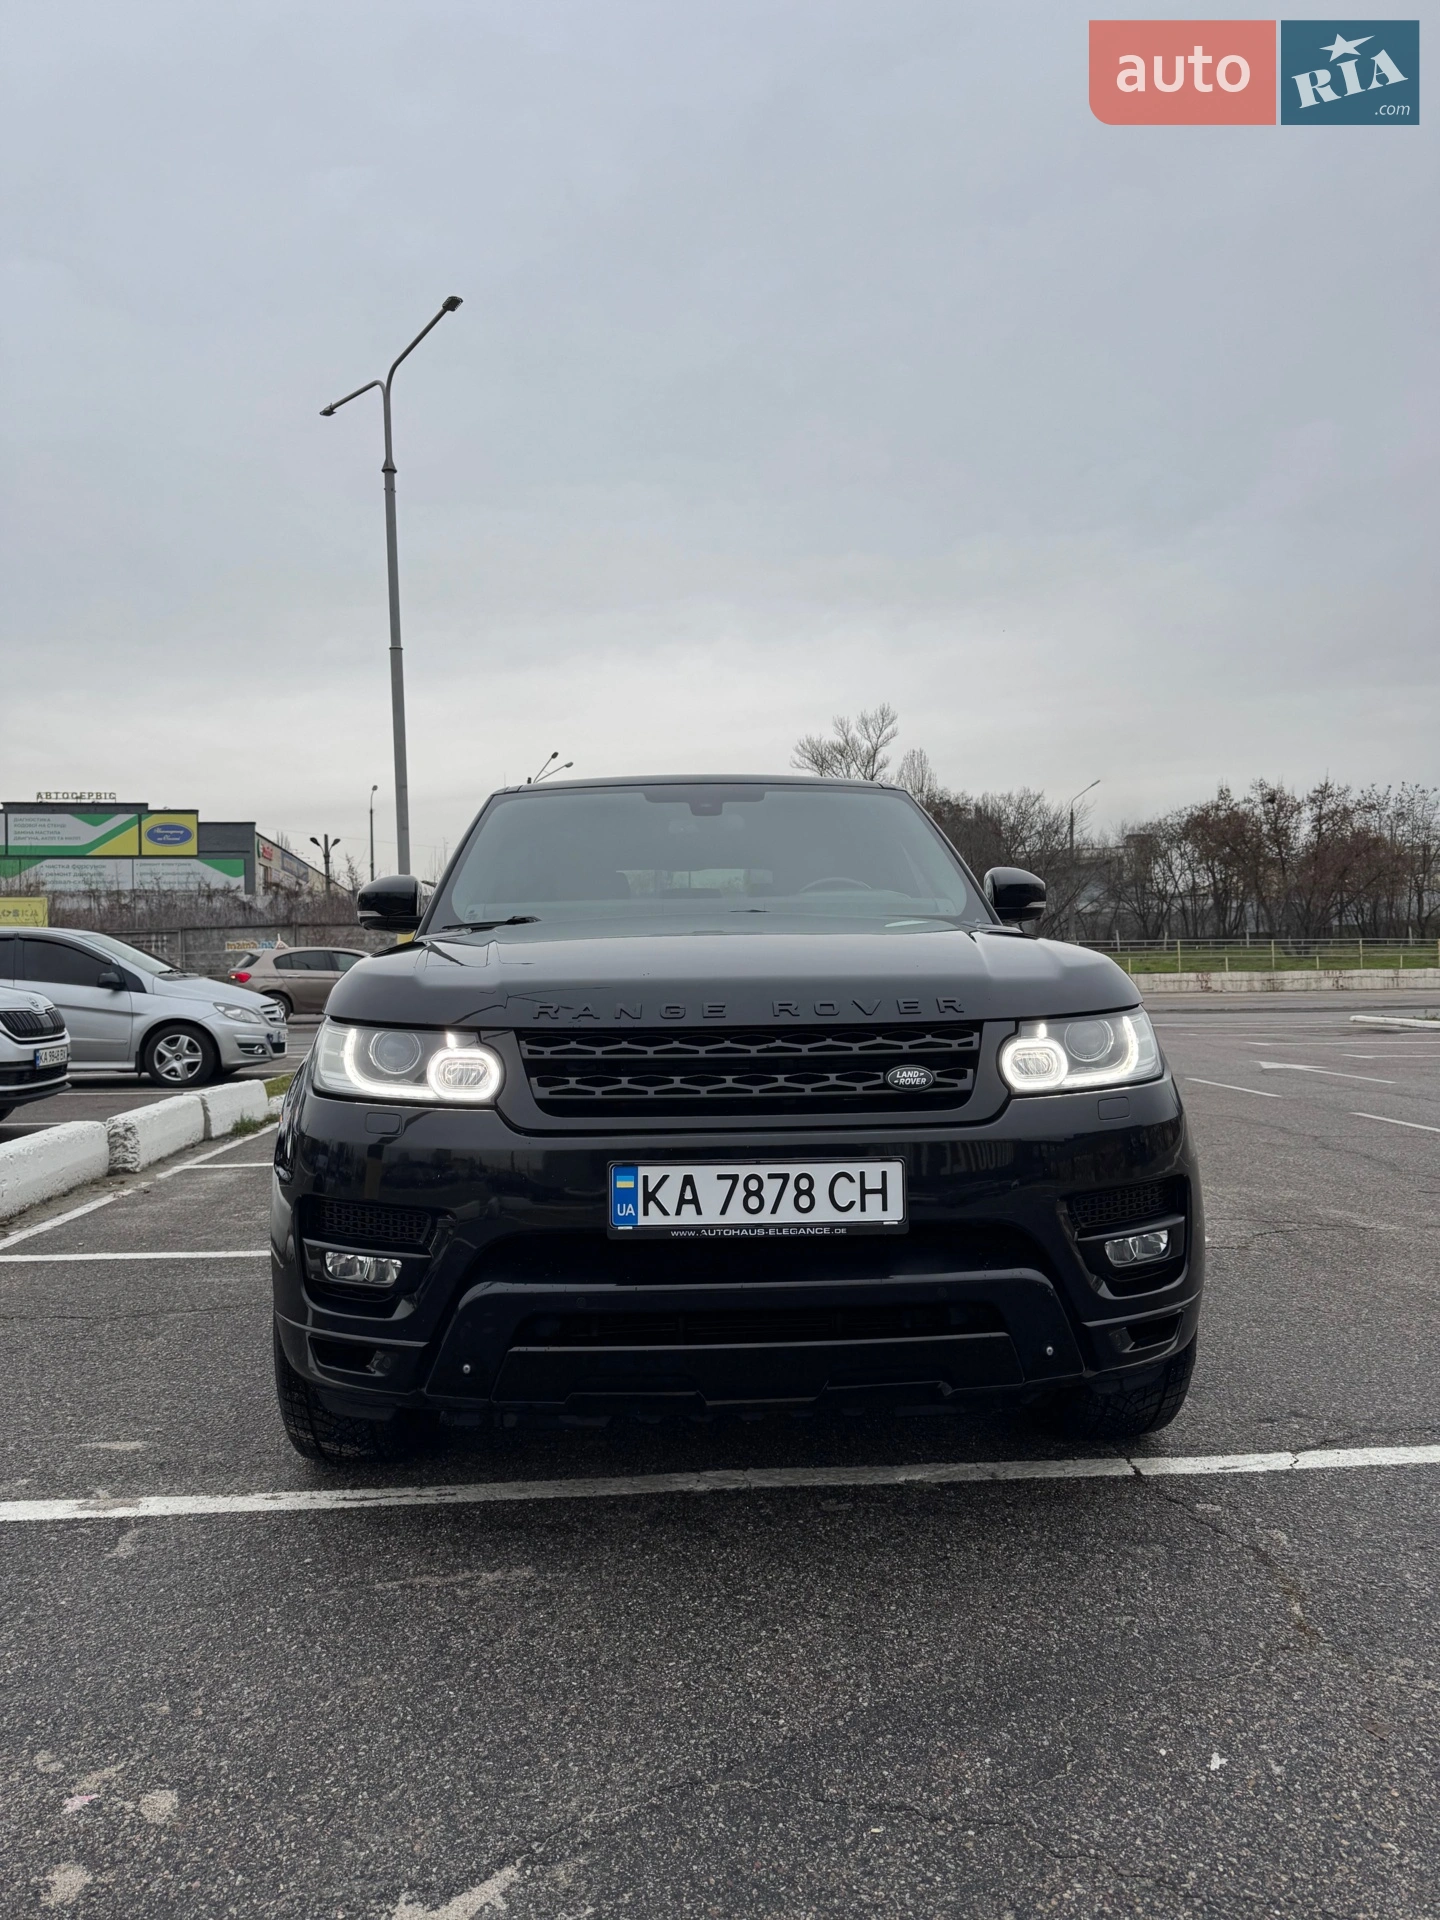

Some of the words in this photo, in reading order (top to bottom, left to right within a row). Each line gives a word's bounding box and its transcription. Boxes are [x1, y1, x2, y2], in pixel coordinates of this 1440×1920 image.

[36, 791, 117, 800] АВТОСЕРВІС
[532, 1001, 728, 1021] RANGE
[771, 996, 966, 1018] ROVER
[896, 1071, 919, 1079] LAND
[899, 1077, 927, 1086] ROVER
[641, 1173, 704, 1218] KA
[715, 1171, 817, 1216] 7878
[827, 1169, 889, 1214] CH
[616, 1202, 636, 1217] UA
